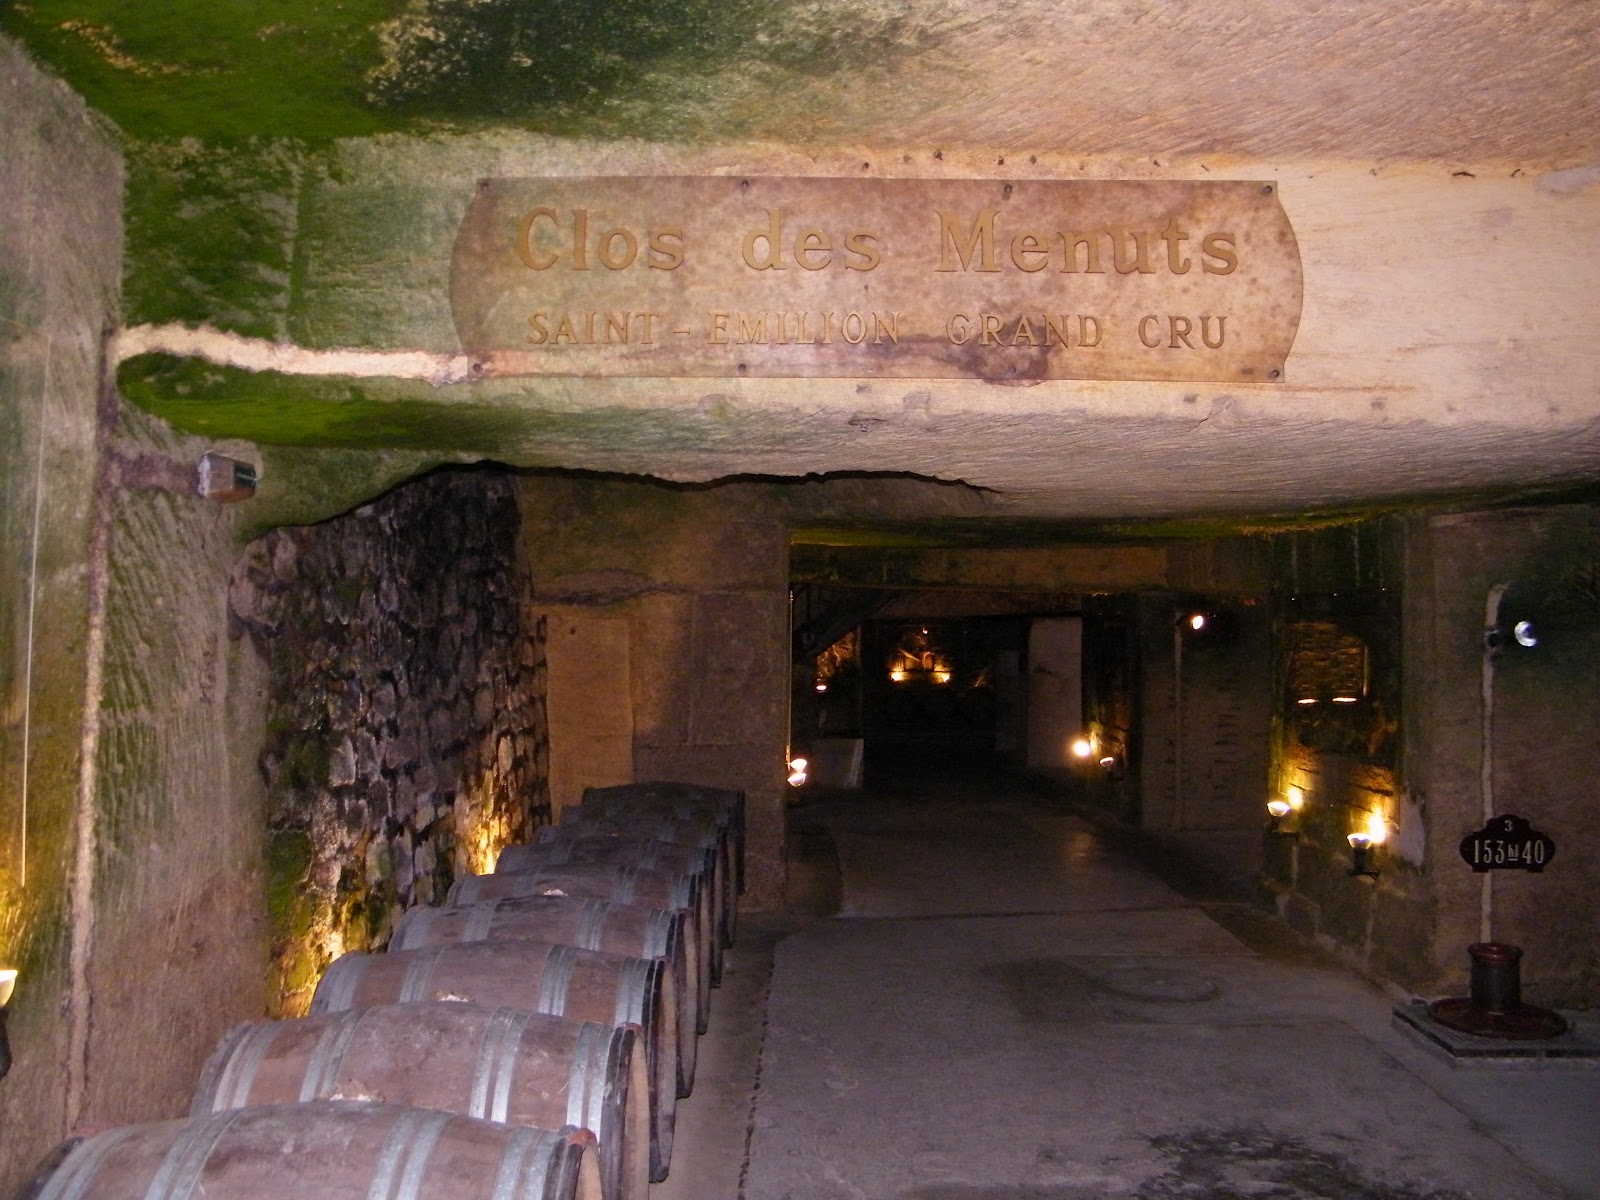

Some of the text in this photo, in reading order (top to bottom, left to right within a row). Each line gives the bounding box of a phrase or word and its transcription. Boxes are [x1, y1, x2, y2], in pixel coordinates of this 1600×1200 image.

[516, 206, 1239, 276] Clos des Menuts
[527, 311, 660, 345] SAINT
[707, 312, 902, 347] EMILION
[945, 313, 1102, 349] GRAND
[1138, 314, 1227, 350] CRU
[1504, 820, 1513, 832] 3
